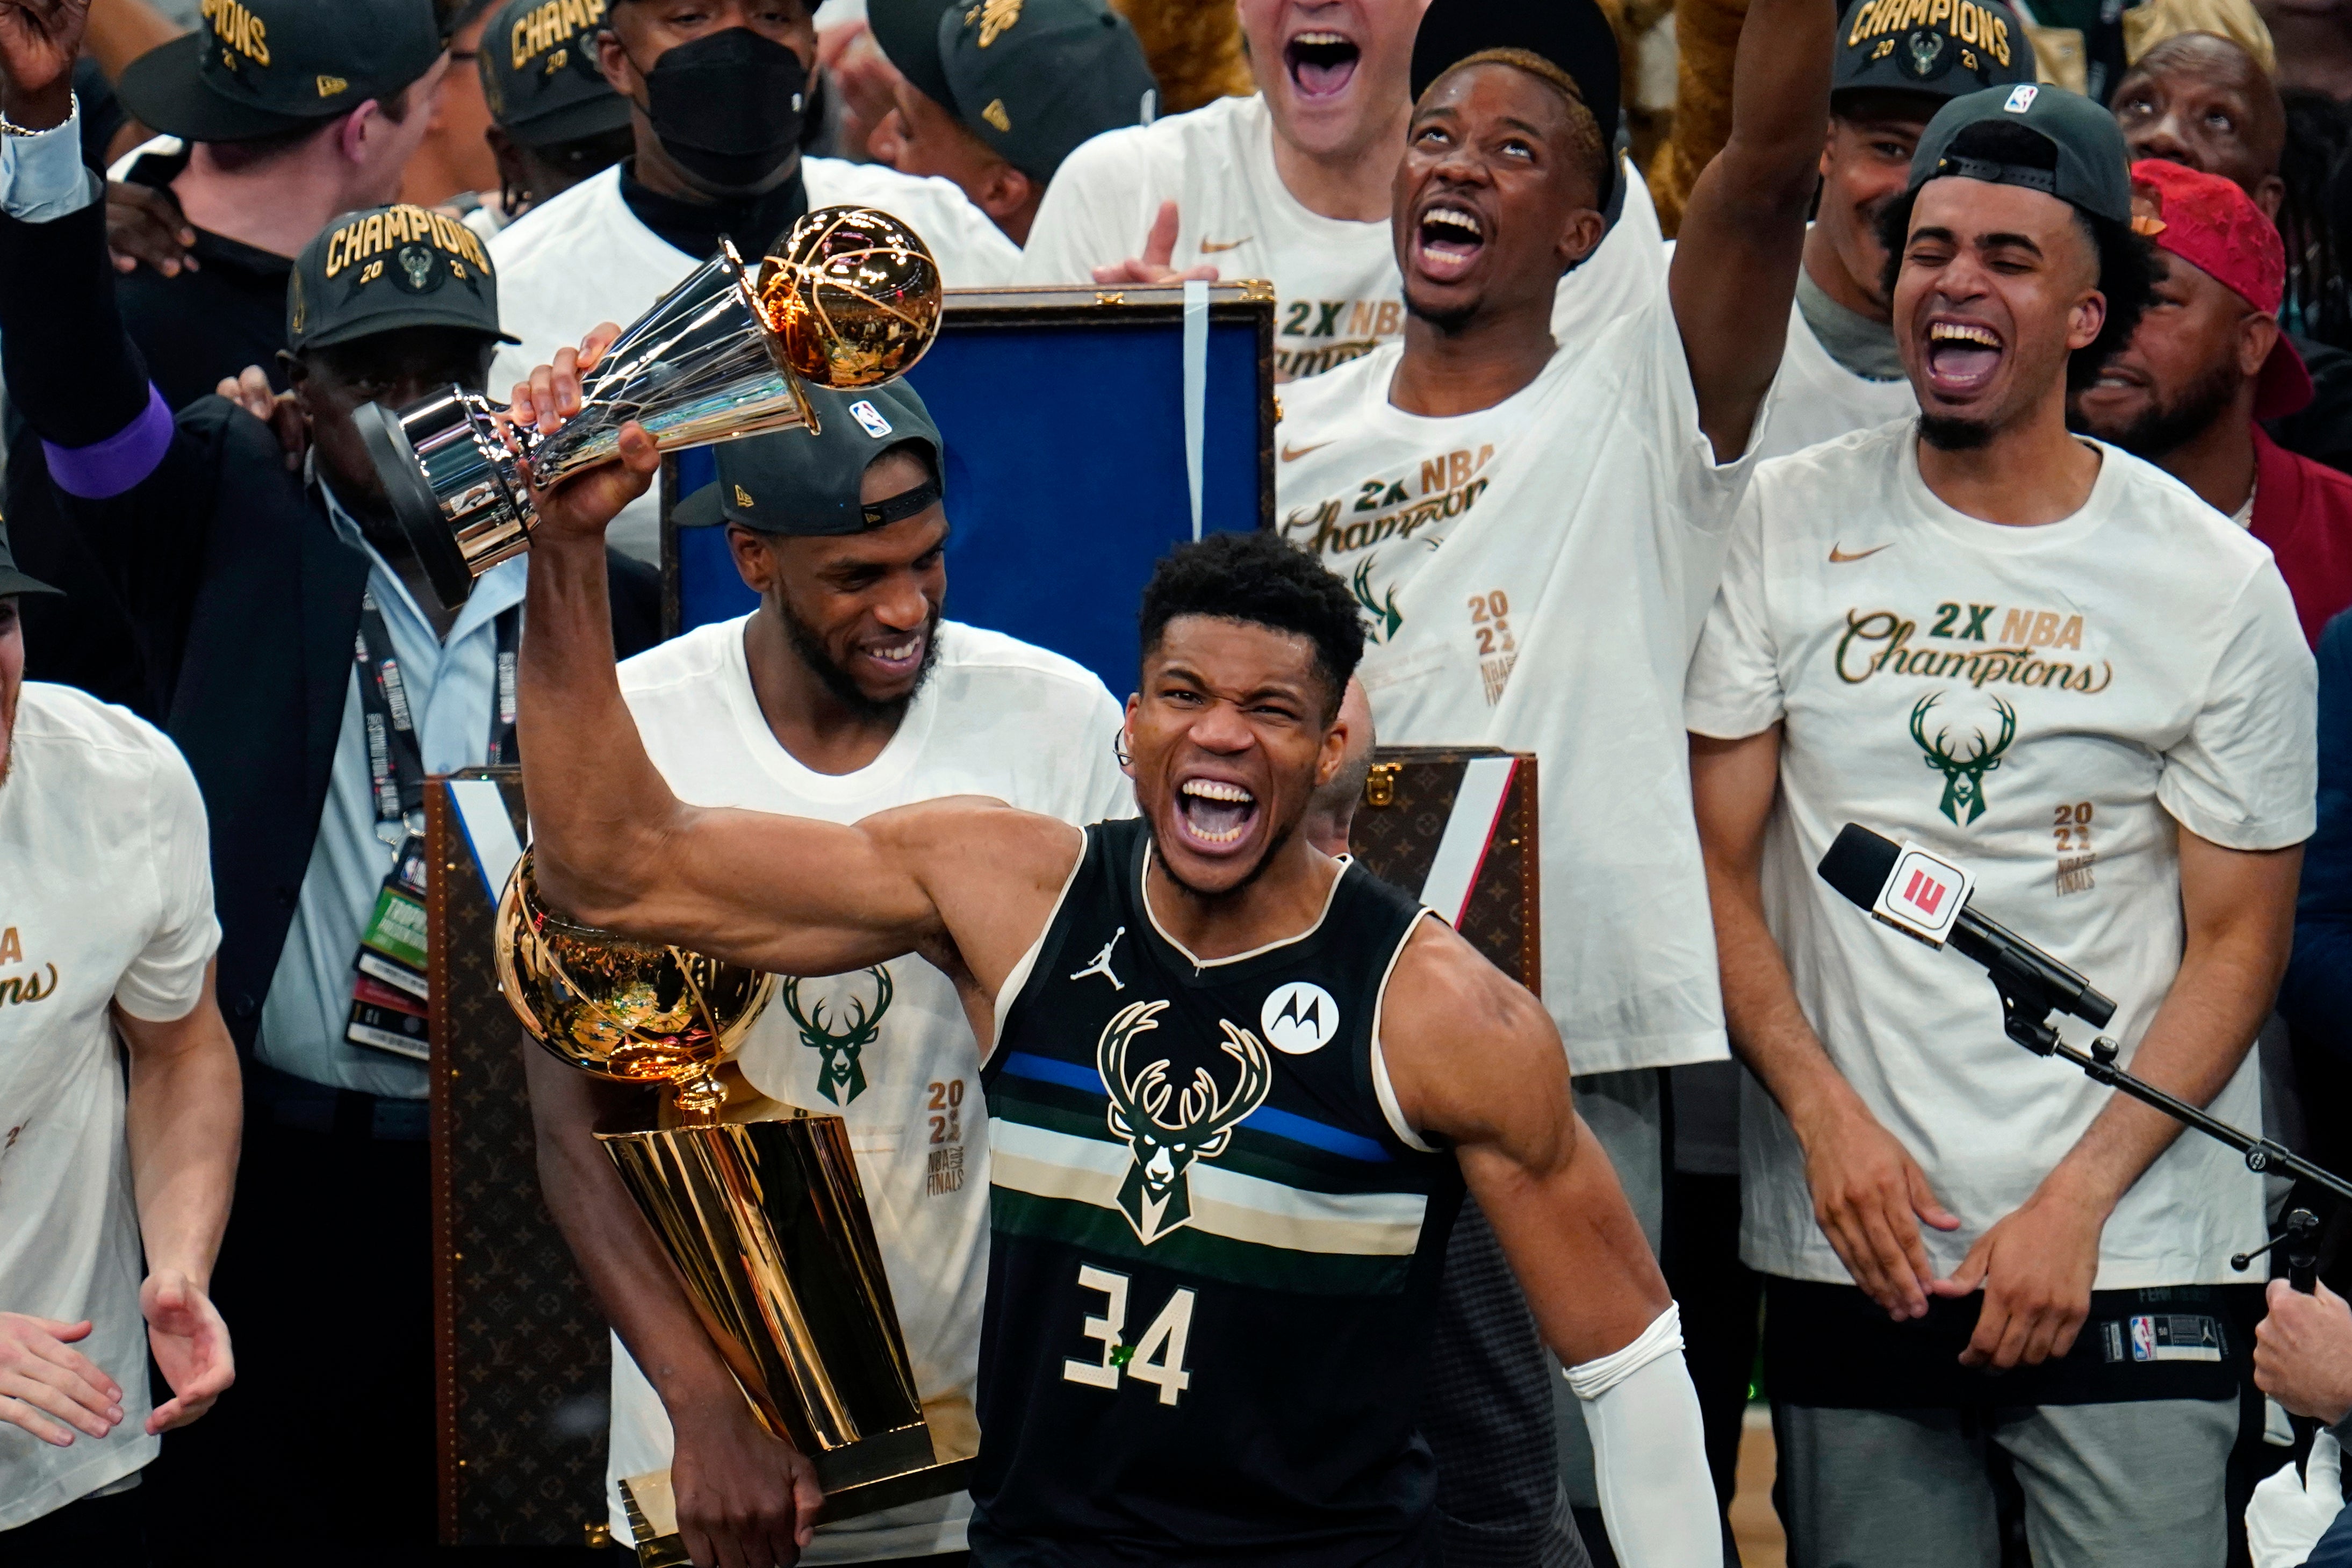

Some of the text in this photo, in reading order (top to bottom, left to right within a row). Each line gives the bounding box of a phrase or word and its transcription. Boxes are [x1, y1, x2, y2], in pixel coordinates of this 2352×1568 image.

[1848, 0, 2011, 68] CHAMPIONS
[1871, 39, 1896, 60] 20
[326, 204, 490, 278] CHAMPIONS
[359, 260, 384, 285] 20
[1282, 301, 1344, 336] 2X
[1468, 589, 1508, 624] 20
[1929, 602, 2084, 651] 2X NBA
[1835, 608, 2113, 694] Champions
[2054, 801, 2093, 825] 20
[927, 1079, 963, 1110] 20
[927, 1149, 950, 1174] NBA
[927, 1168, 964, 1198] FINALS
[1063, 1264, 1195, 1406] 34
